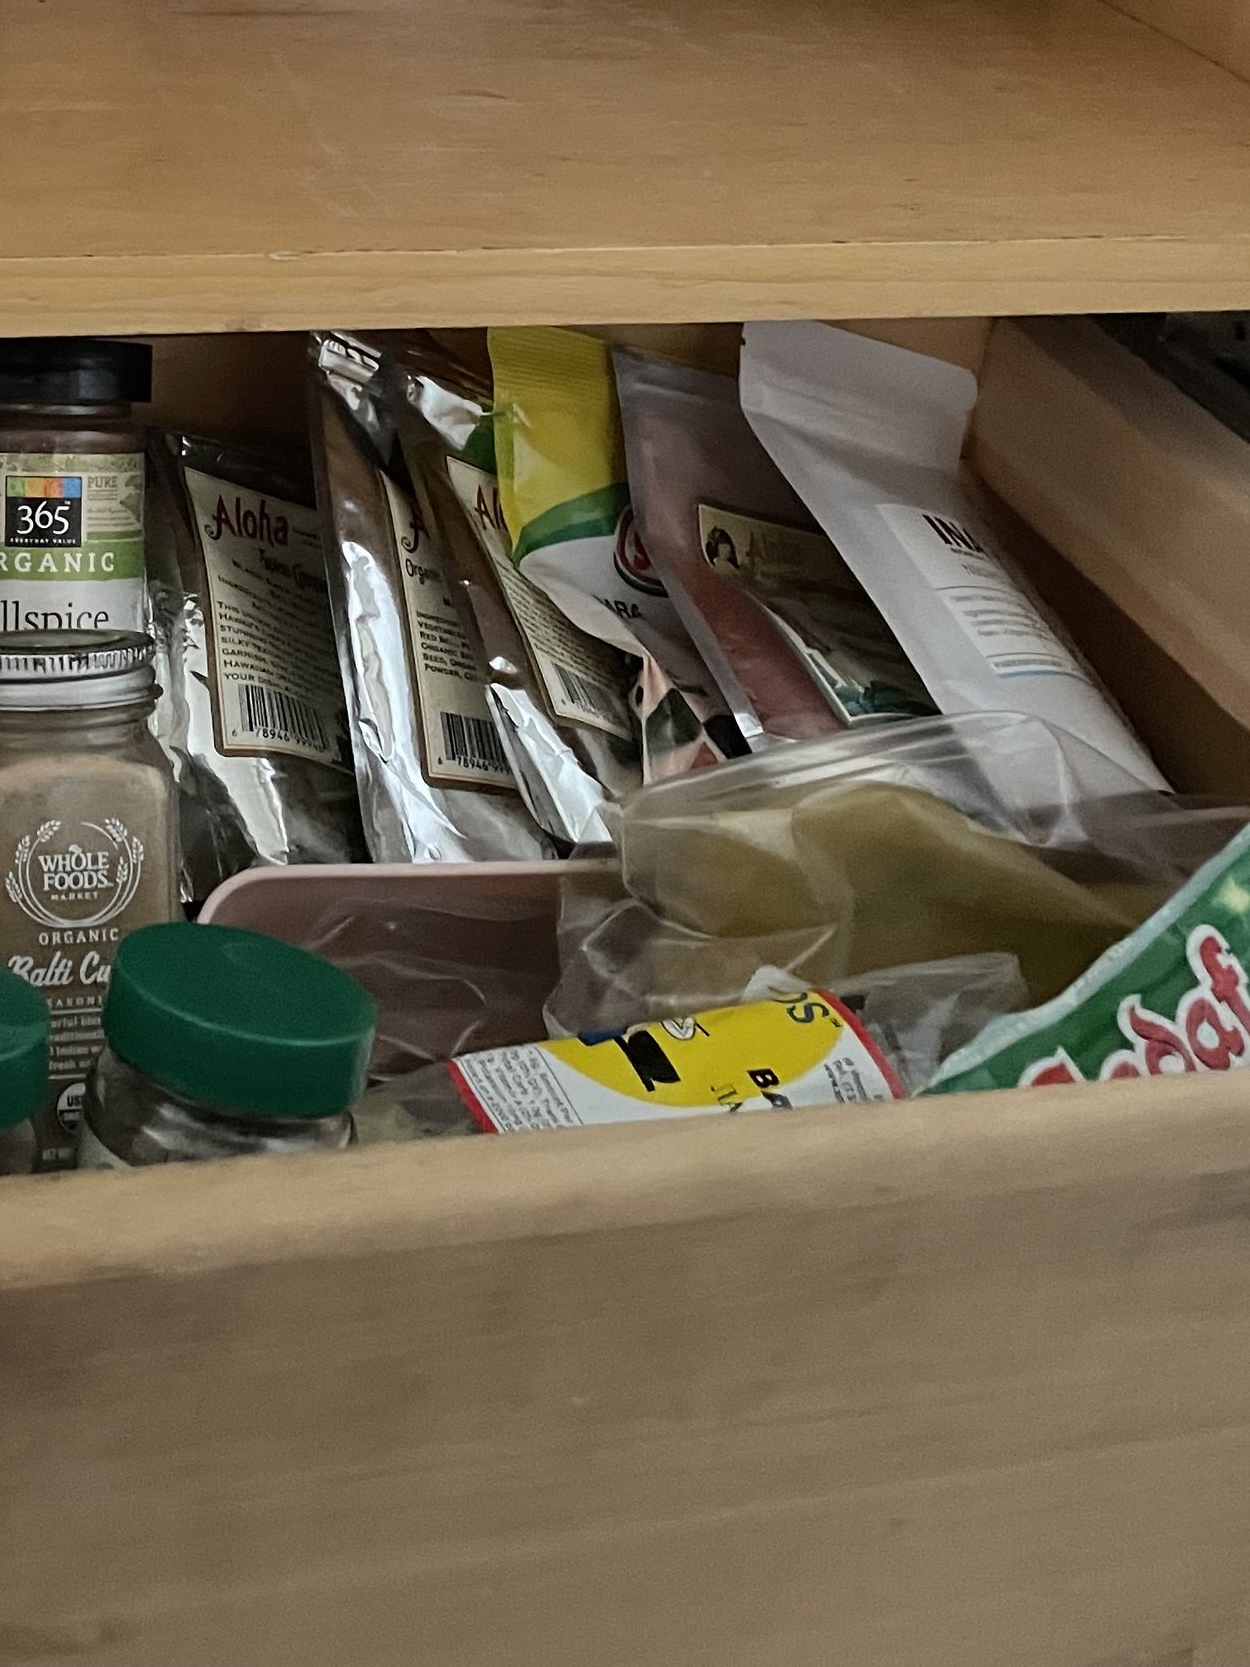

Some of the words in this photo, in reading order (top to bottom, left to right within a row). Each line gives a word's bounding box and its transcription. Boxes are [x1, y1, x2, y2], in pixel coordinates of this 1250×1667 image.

[88, 477, 118, 488] PURE
[17, 500, 70, 535] 365
[205, 494, 289, 547] Aloha
[11, 537, 49, 545] EVERYDAY
[53, 537, 77, 545] VALUE
[224, 672, 255, 683] YOUR
[38, 850, 110, 872] WHOLE
[44, 871, 113, 891] FOODS
[50, 892, 99, 901] MARKET
[38, 928, 120, 945] ORGANIC
[8, 951, 74, 987] Balti
[80, 952, 112, 985] Cu
